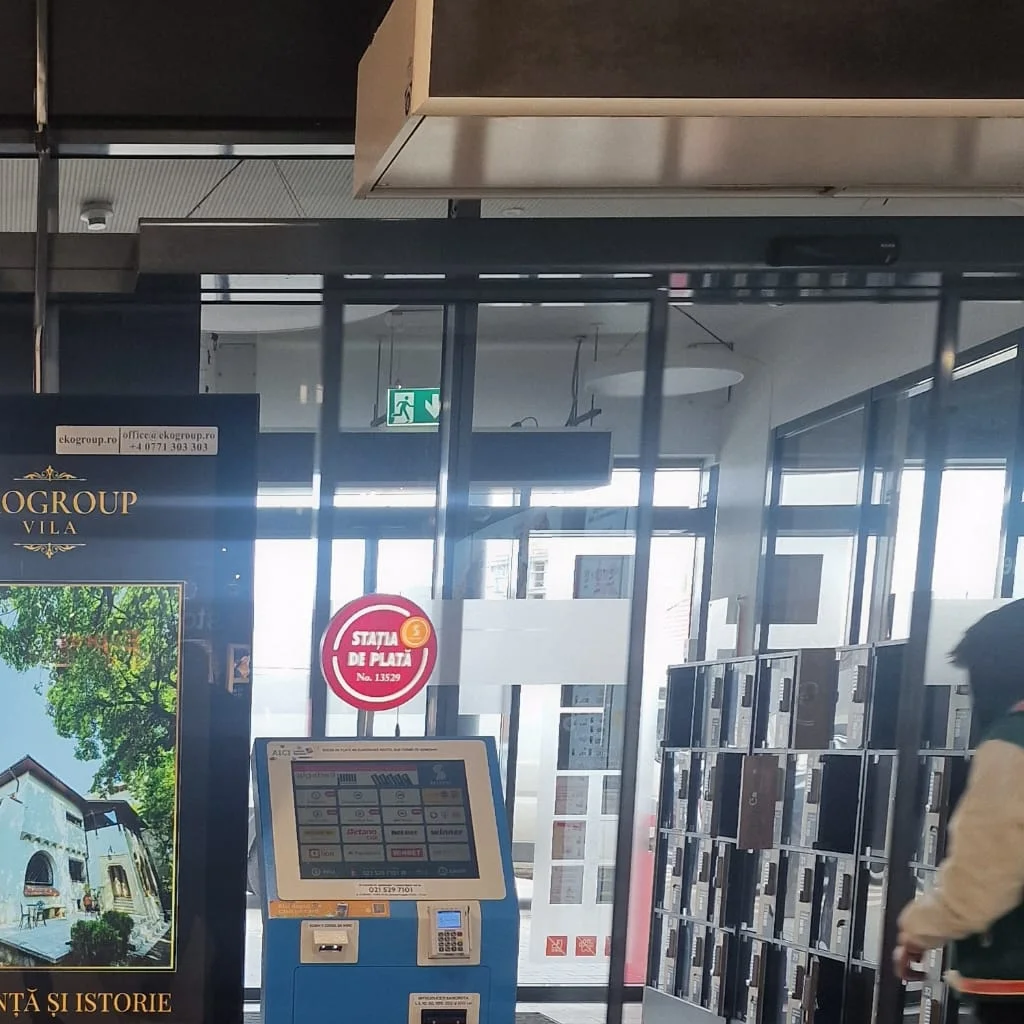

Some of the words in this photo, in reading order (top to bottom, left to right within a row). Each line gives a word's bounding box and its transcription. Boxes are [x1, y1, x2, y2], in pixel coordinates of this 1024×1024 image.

[59, 434, 117, 446] ekogroup.ro
[145, 442, 167, 451] 0771
[171, 442, 188, 451] 303
[190, 442, 208, 451] 303
[23, 521, 77, 535] VILA
[351, 631, 398, 651] STAȚIA
[347, 652, 366, 667] DE
[369, 649, 412, 667] PLATĂ
[356, 672, 373, 682] No.
[375, 673, 401, 682] 13529
[47, 992, 68, 1018] ȘI
[76, 992, 172, 1013] ISTORIE
